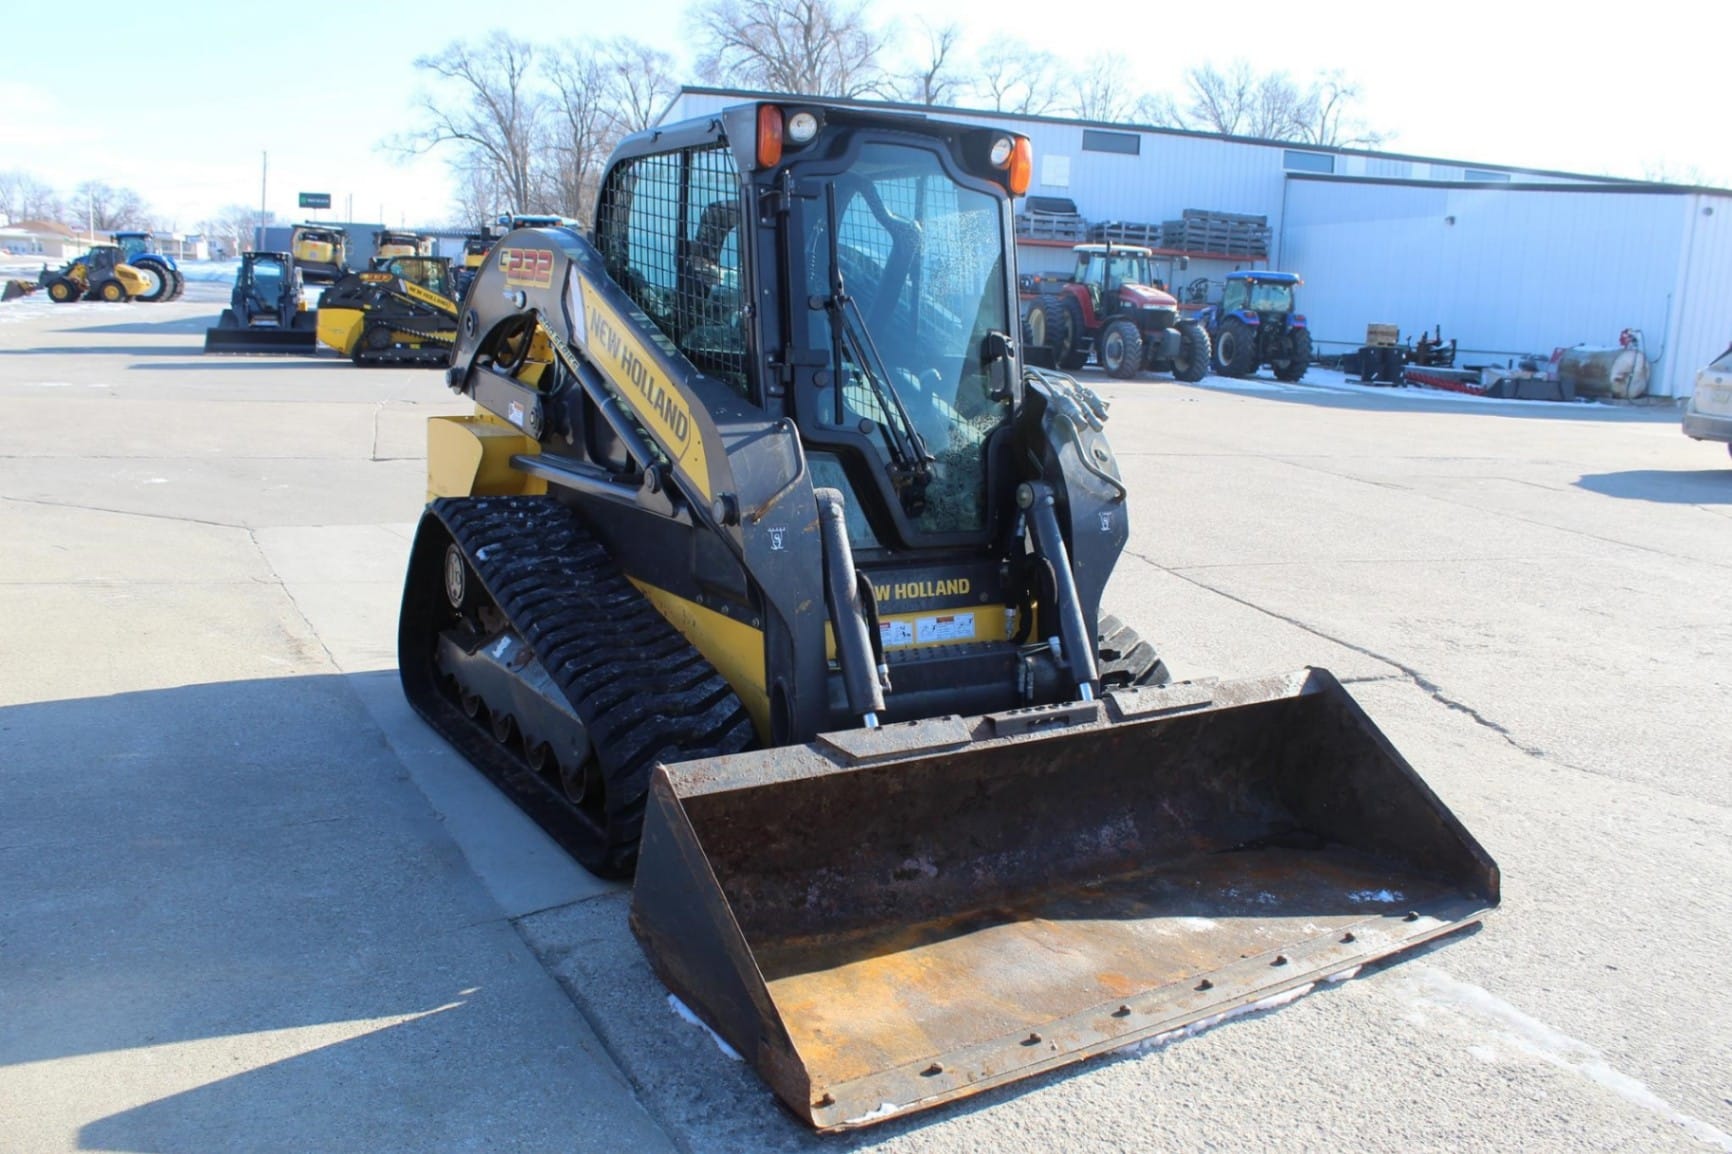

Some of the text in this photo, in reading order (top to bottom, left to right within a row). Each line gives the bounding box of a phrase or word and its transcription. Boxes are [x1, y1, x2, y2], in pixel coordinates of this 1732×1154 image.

[590, 308, 689, 442] NEW HOLLAND
[873, 578, 970, 602] W HOLLAND
